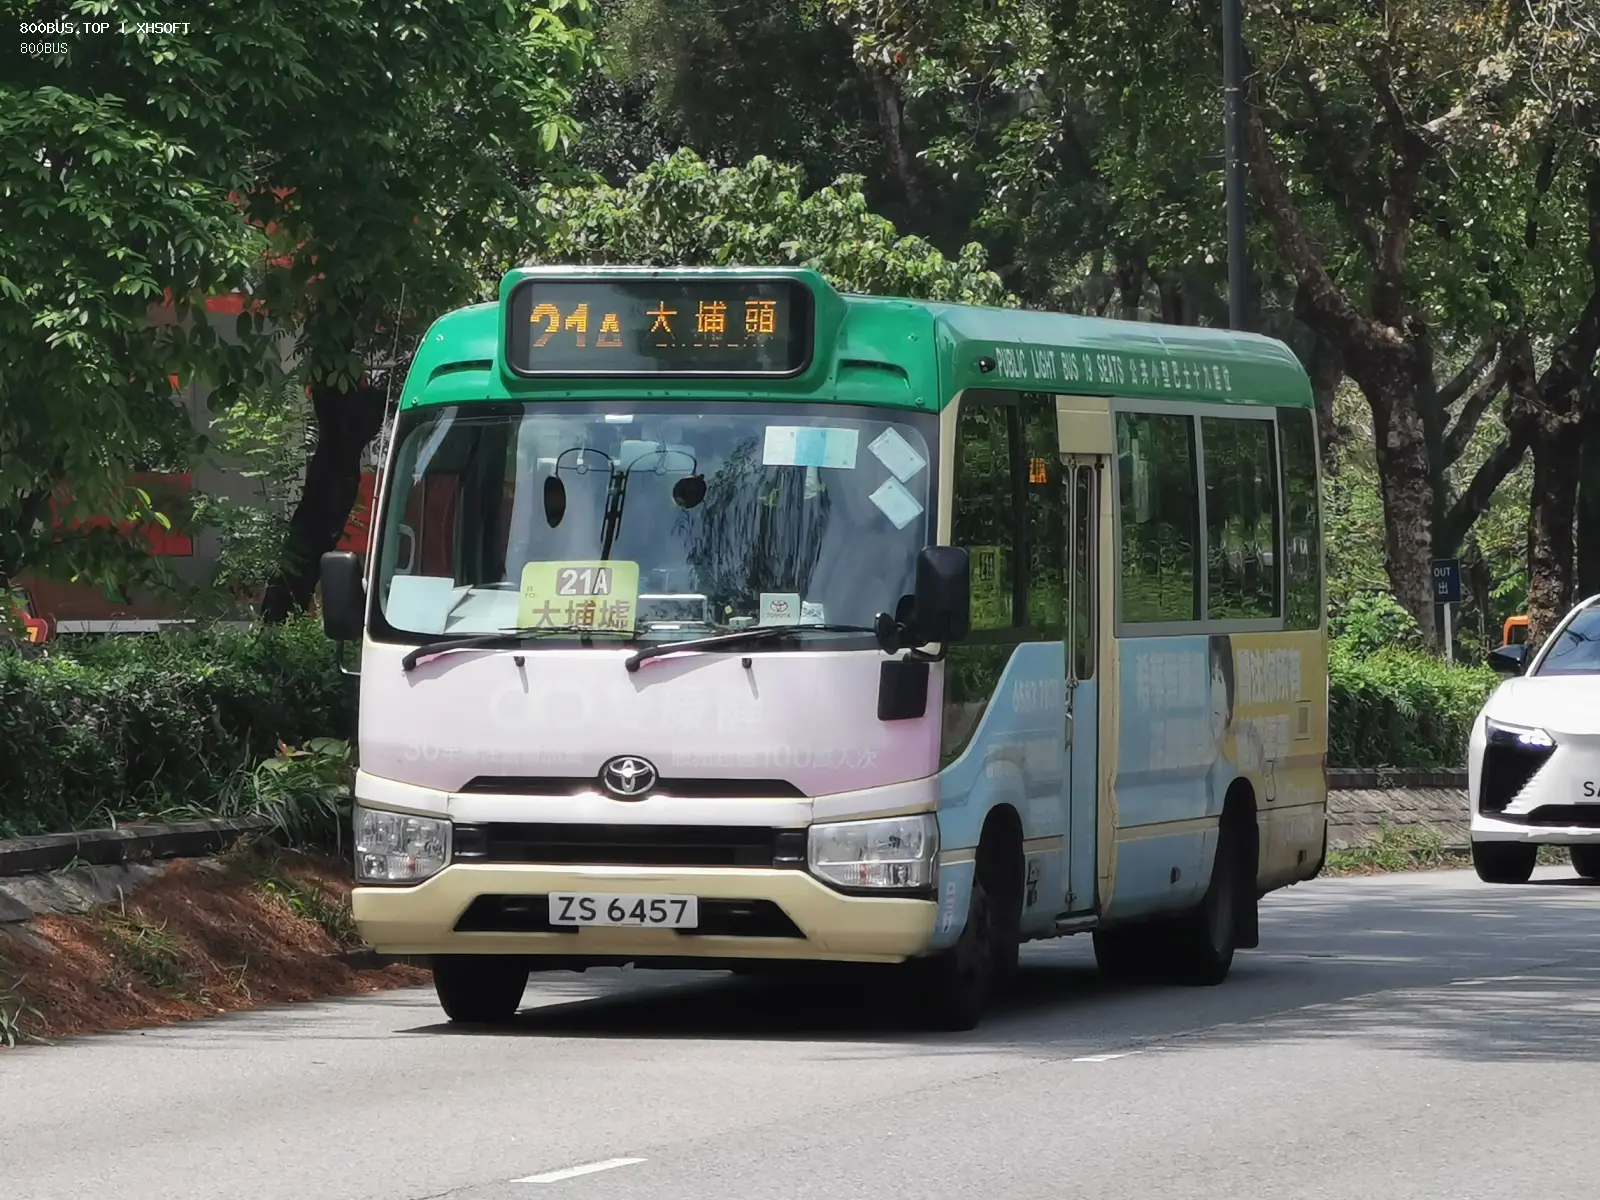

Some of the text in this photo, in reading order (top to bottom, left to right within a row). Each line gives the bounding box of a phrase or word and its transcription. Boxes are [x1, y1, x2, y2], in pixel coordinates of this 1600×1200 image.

[530, 303, 623, 347] 21A
[646, 301, 777, 339] 大埔頭
[995, 347, 1027, 379] PUBLIC
[1030, 349, 1056, 380] LIGHT
[1060, 352, 1079, 381] BUS
[1096, 353, 1125, 385] SEATS
[560, 568, 609, 595] 21A
[1433, 566, 1451, 577] OUT
[1438, 581, 1449, 595] 出
[532, 600, 630, 630] 大埔墟
[1583, 780, 1600, 797] S
[558, 896, 688, 924] ZS 6457
